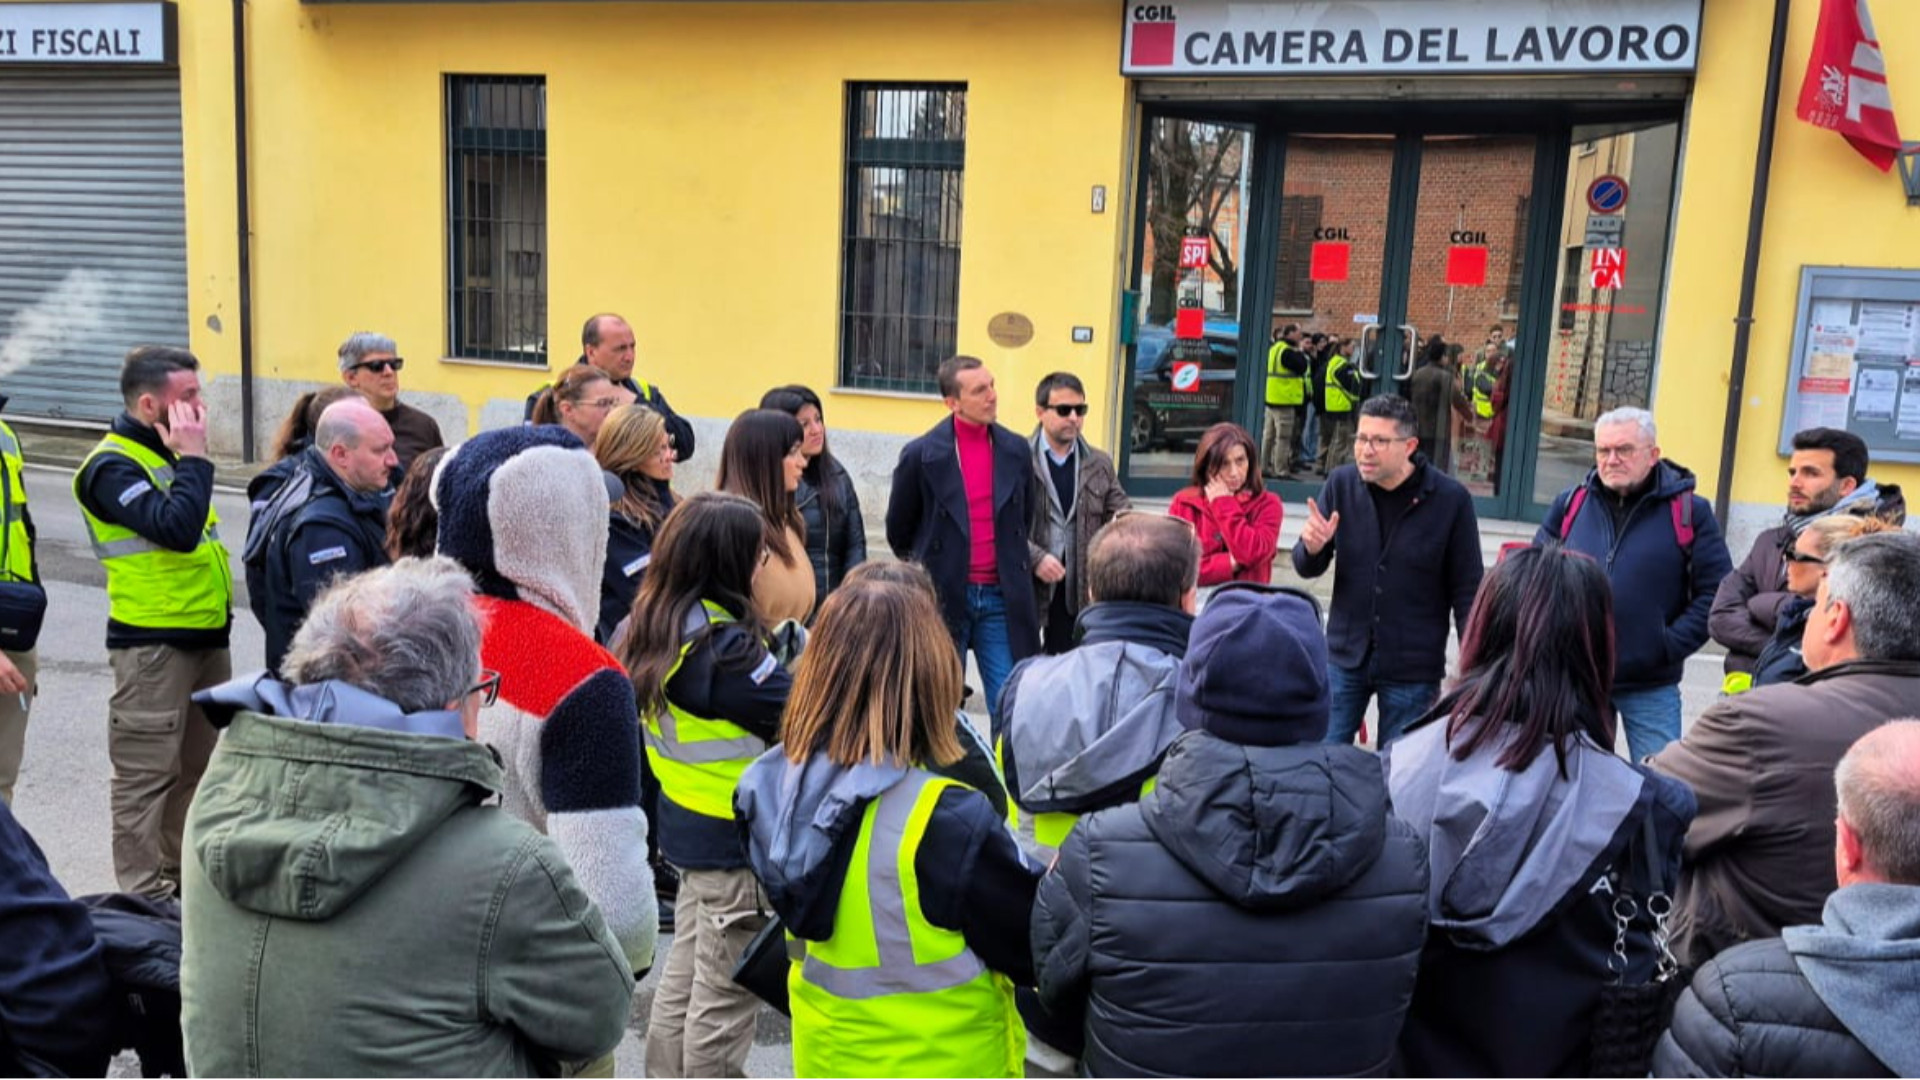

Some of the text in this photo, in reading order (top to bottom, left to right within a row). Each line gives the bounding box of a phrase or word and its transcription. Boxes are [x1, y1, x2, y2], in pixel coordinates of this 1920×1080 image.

[1134, 5, 1177, 20] CGIL
[0, 29, 141, 56] I FISCALI
[1183, 24, 1690, 66] CAMERA DEL LAVORO
[1313, 226, 1350, 240] CGIL
[1450, 231, 1488, 244] CGIL
[1182, 244, 1207, 264] SPI
[1595, 247, 1622, 266] IN
[1590, 267, 1622, 289] CA
